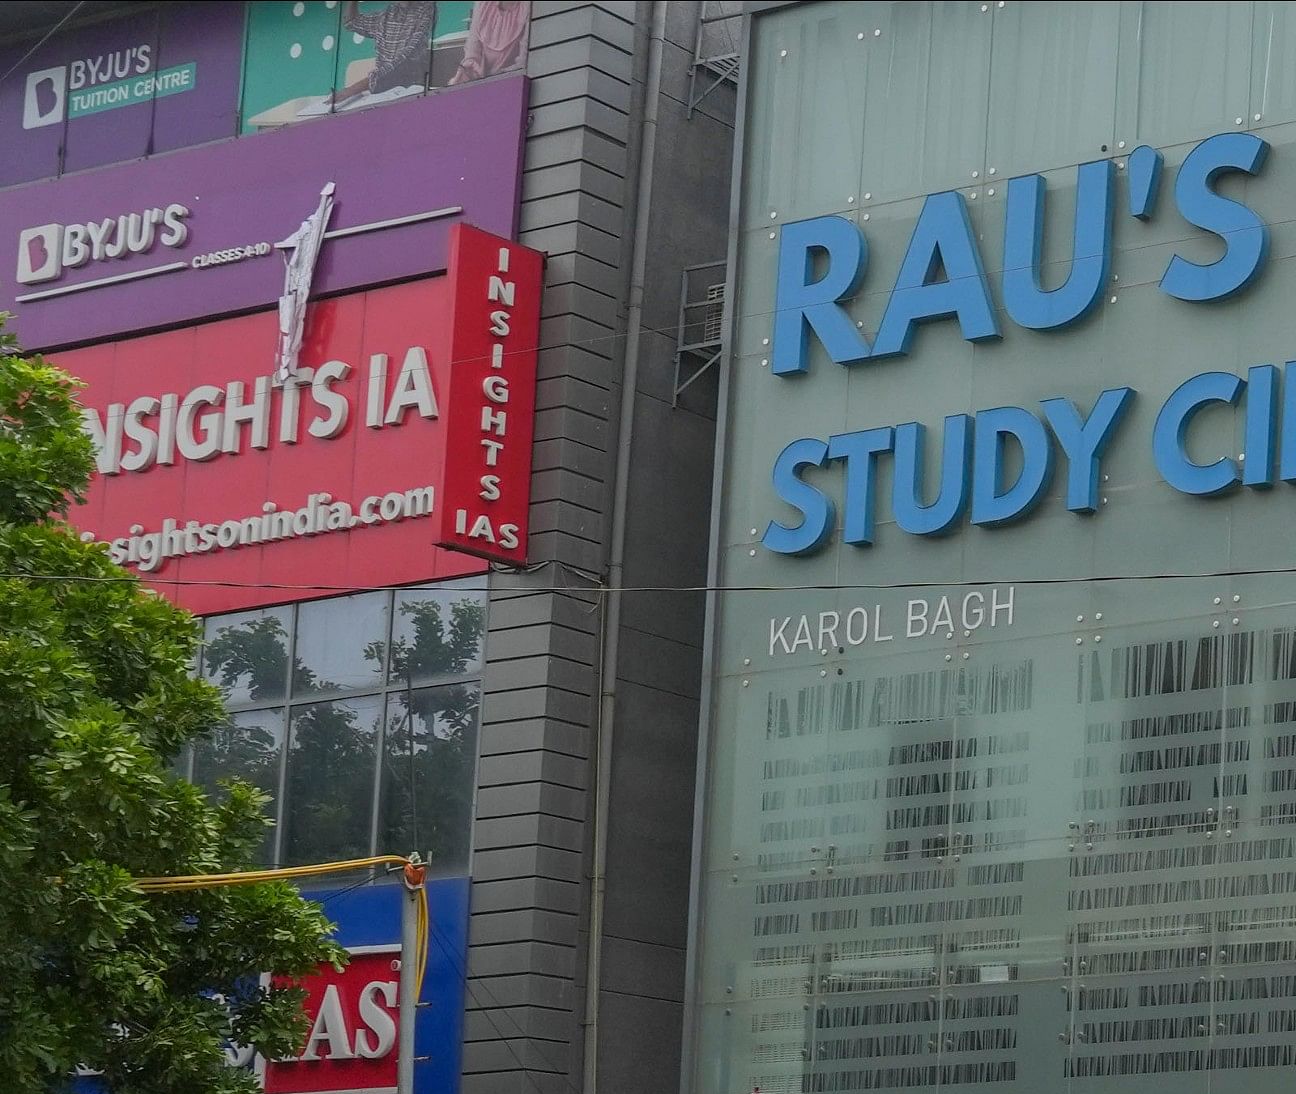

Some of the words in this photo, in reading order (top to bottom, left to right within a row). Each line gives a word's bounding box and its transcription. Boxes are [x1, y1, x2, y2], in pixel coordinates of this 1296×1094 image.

[70, 44, 151, 90] BYJU'S
[72, 84, 129, 111] TUITION
[133, 69, 190, 97] CENTRE
[62, 203, 190, 267] BYJU'S
[192, 247, 245, 268] CLASSES
[771, 131, 1271, 378] RAU'S
[480, 247, 516, 501] INSIGHTS
[762, 386, 1136, 557] STUDY
[455, 509, 519, 549] IAS
[769, 604, 894, 656] KAROL
[906, 586, 1015, 638] BAGH
